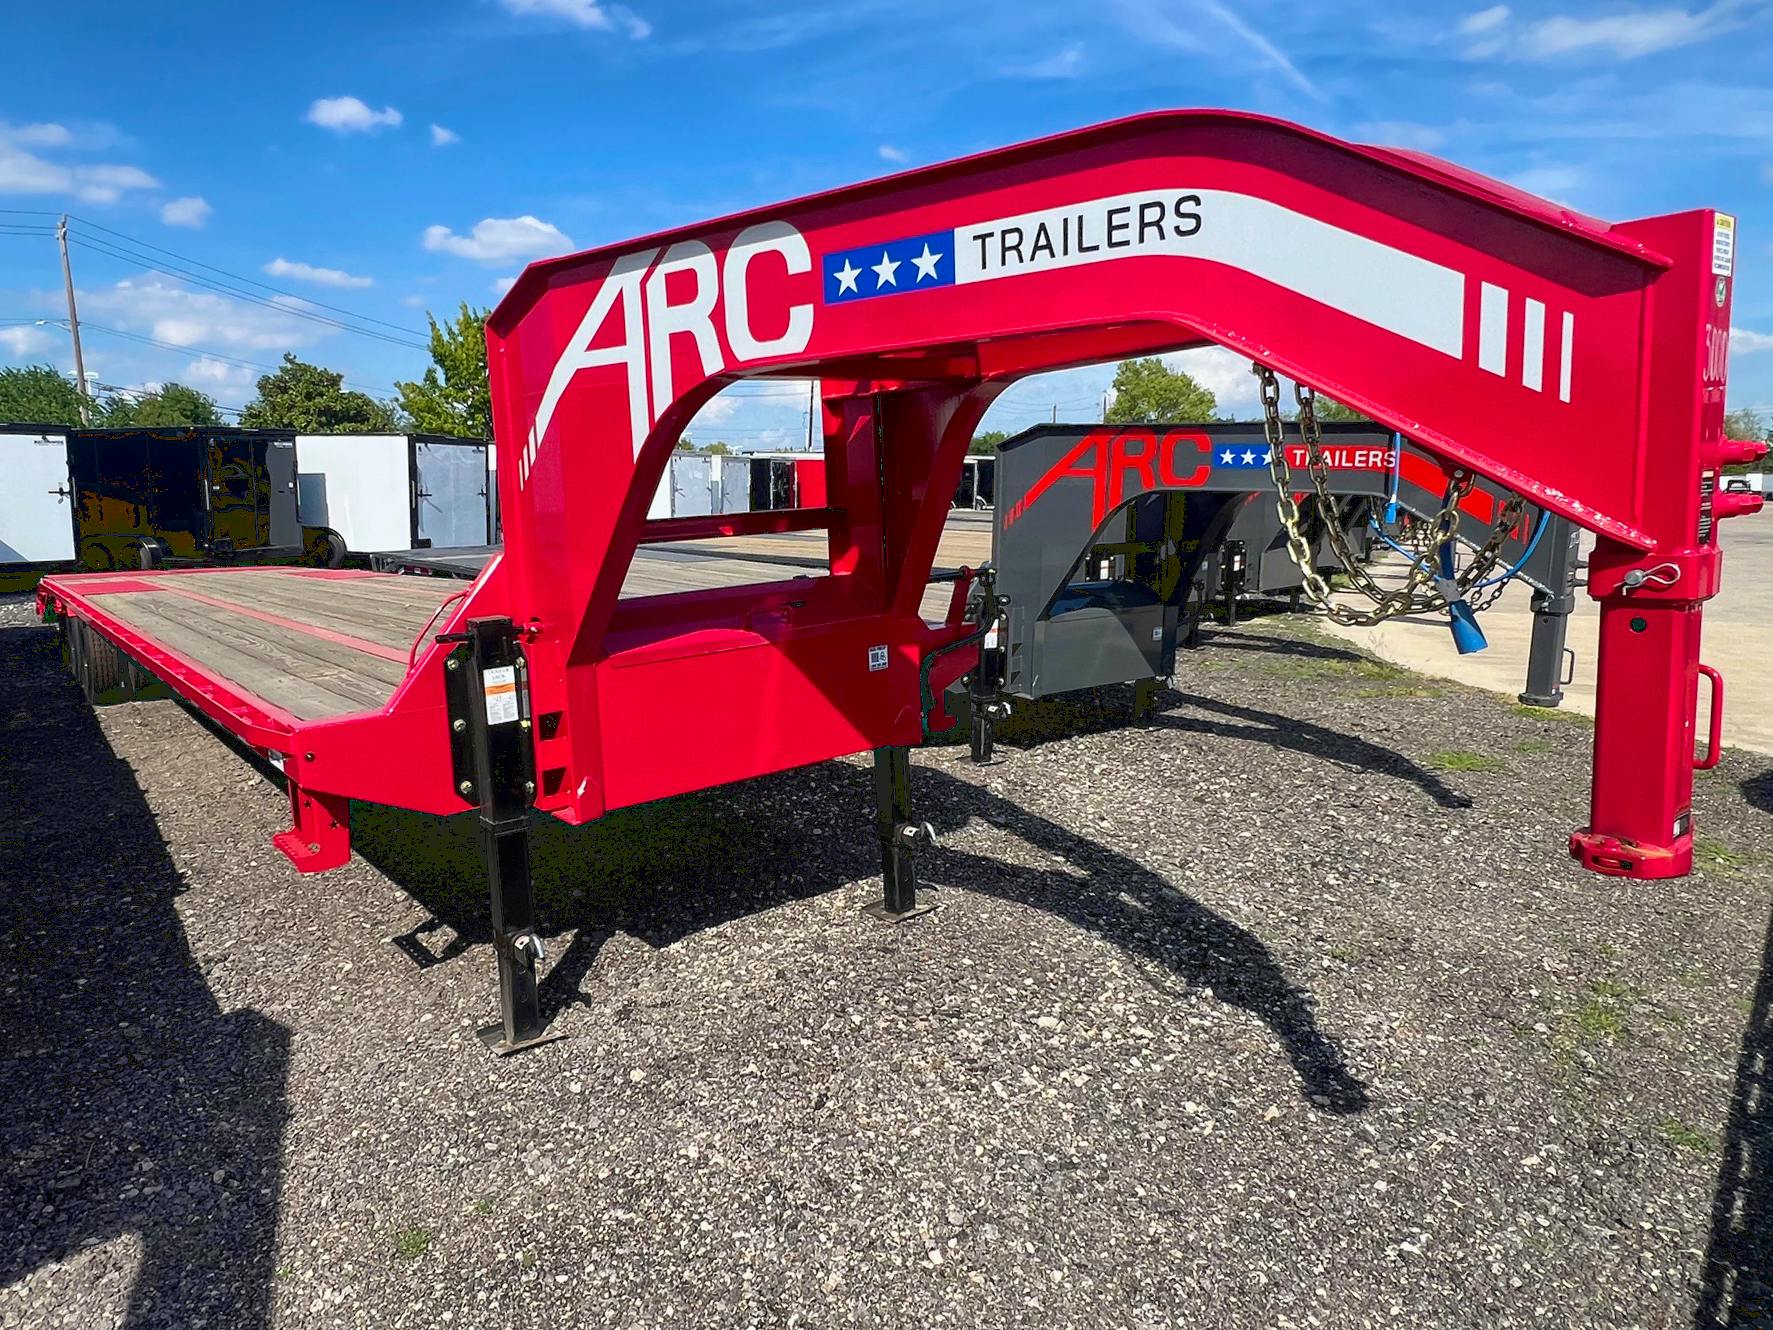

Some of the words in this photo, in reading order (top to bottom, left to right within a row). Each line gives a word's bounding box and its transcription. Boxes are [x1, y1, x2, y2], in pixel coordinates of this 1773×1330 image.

[535, 220, 813, 464] ARC
[972, 193, 1203, 271] TRAILERS
[1023, 427, 1213, 533] ARC
